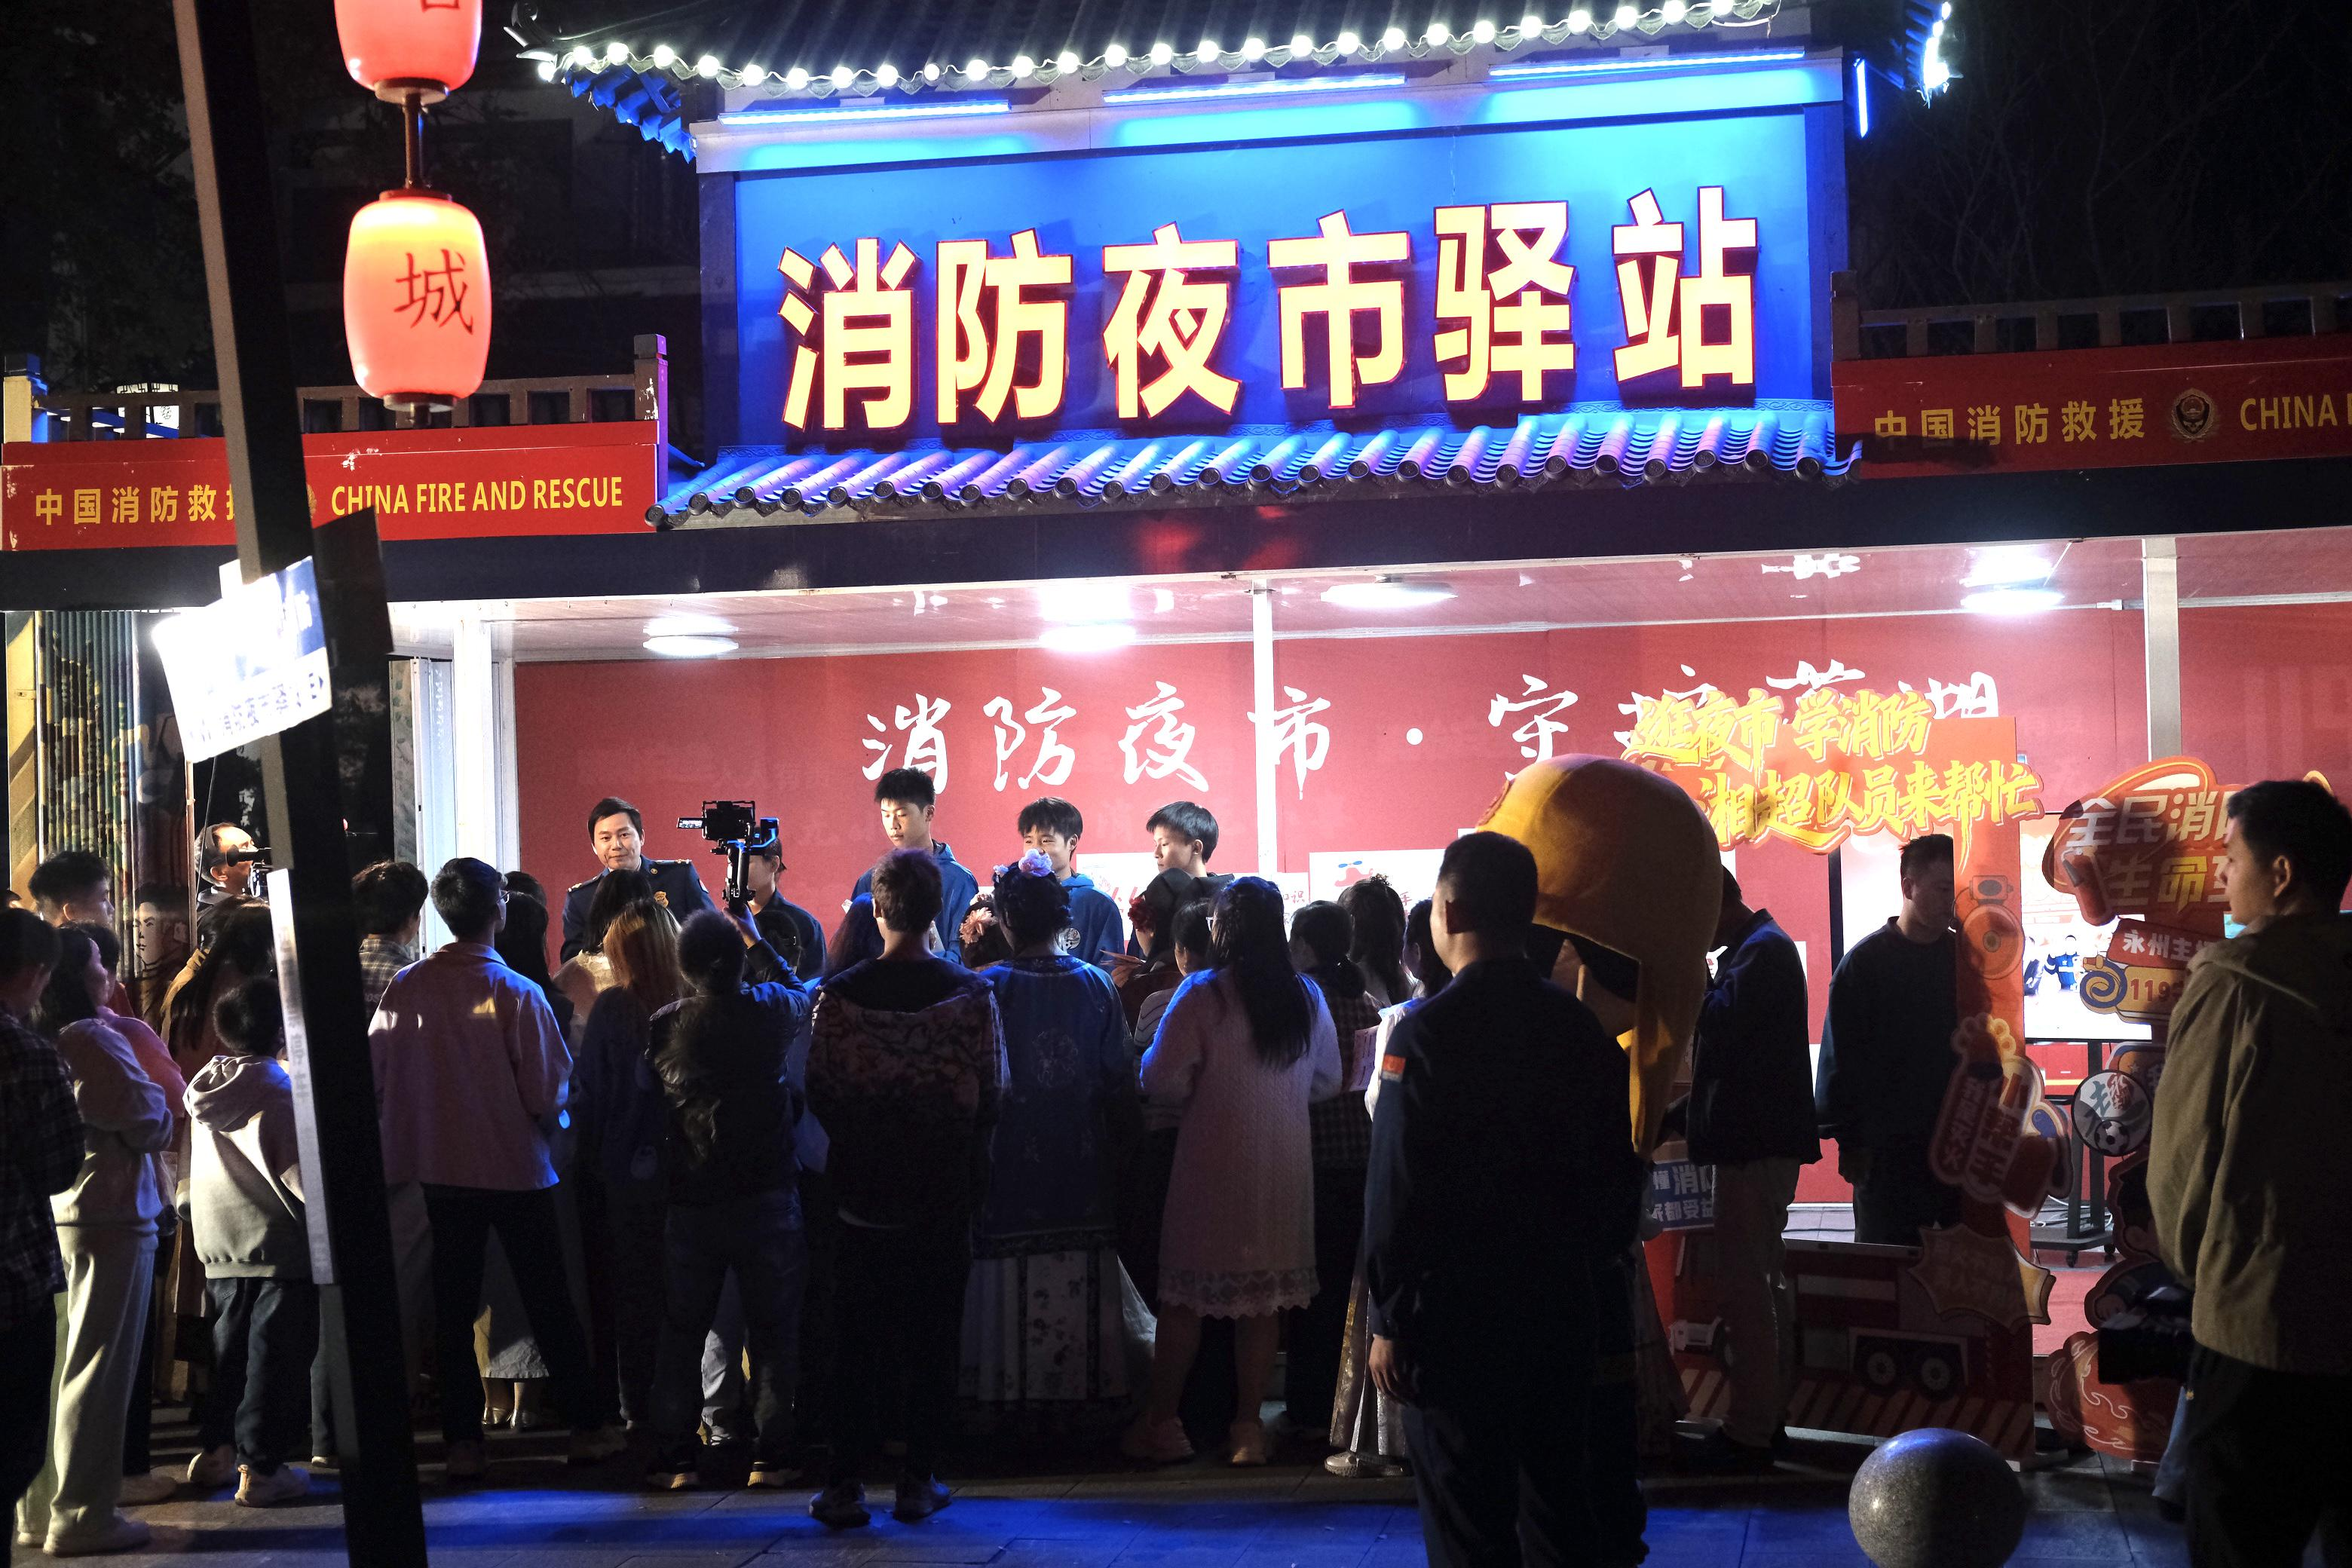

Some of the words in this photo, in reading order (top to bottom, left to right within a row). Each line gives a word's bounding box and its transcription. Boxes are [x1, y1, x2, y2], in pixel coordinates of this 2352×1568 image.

[393, 248, 474, 335] 城
[777, 184, 1757, 433] 消防夜市驿站
[1874, 397, 2145, 451] 中国消防救援
[2240, 394, 2337, 431] CHINA
[35, 484, 236, 525] 中国消防救
[330, 485, 409, 516] CHINA
[416, 482, 466, 513] FIRE
[472, 480, 526, 511] AND
[533, 476, 623, 510] RESCUE
[1628, 688, 1781, 786] 逛夜市
[1793, 688, 1934, 760] 学消防
[1698, 758, 2042, 873] 湘超队员来帮忙
